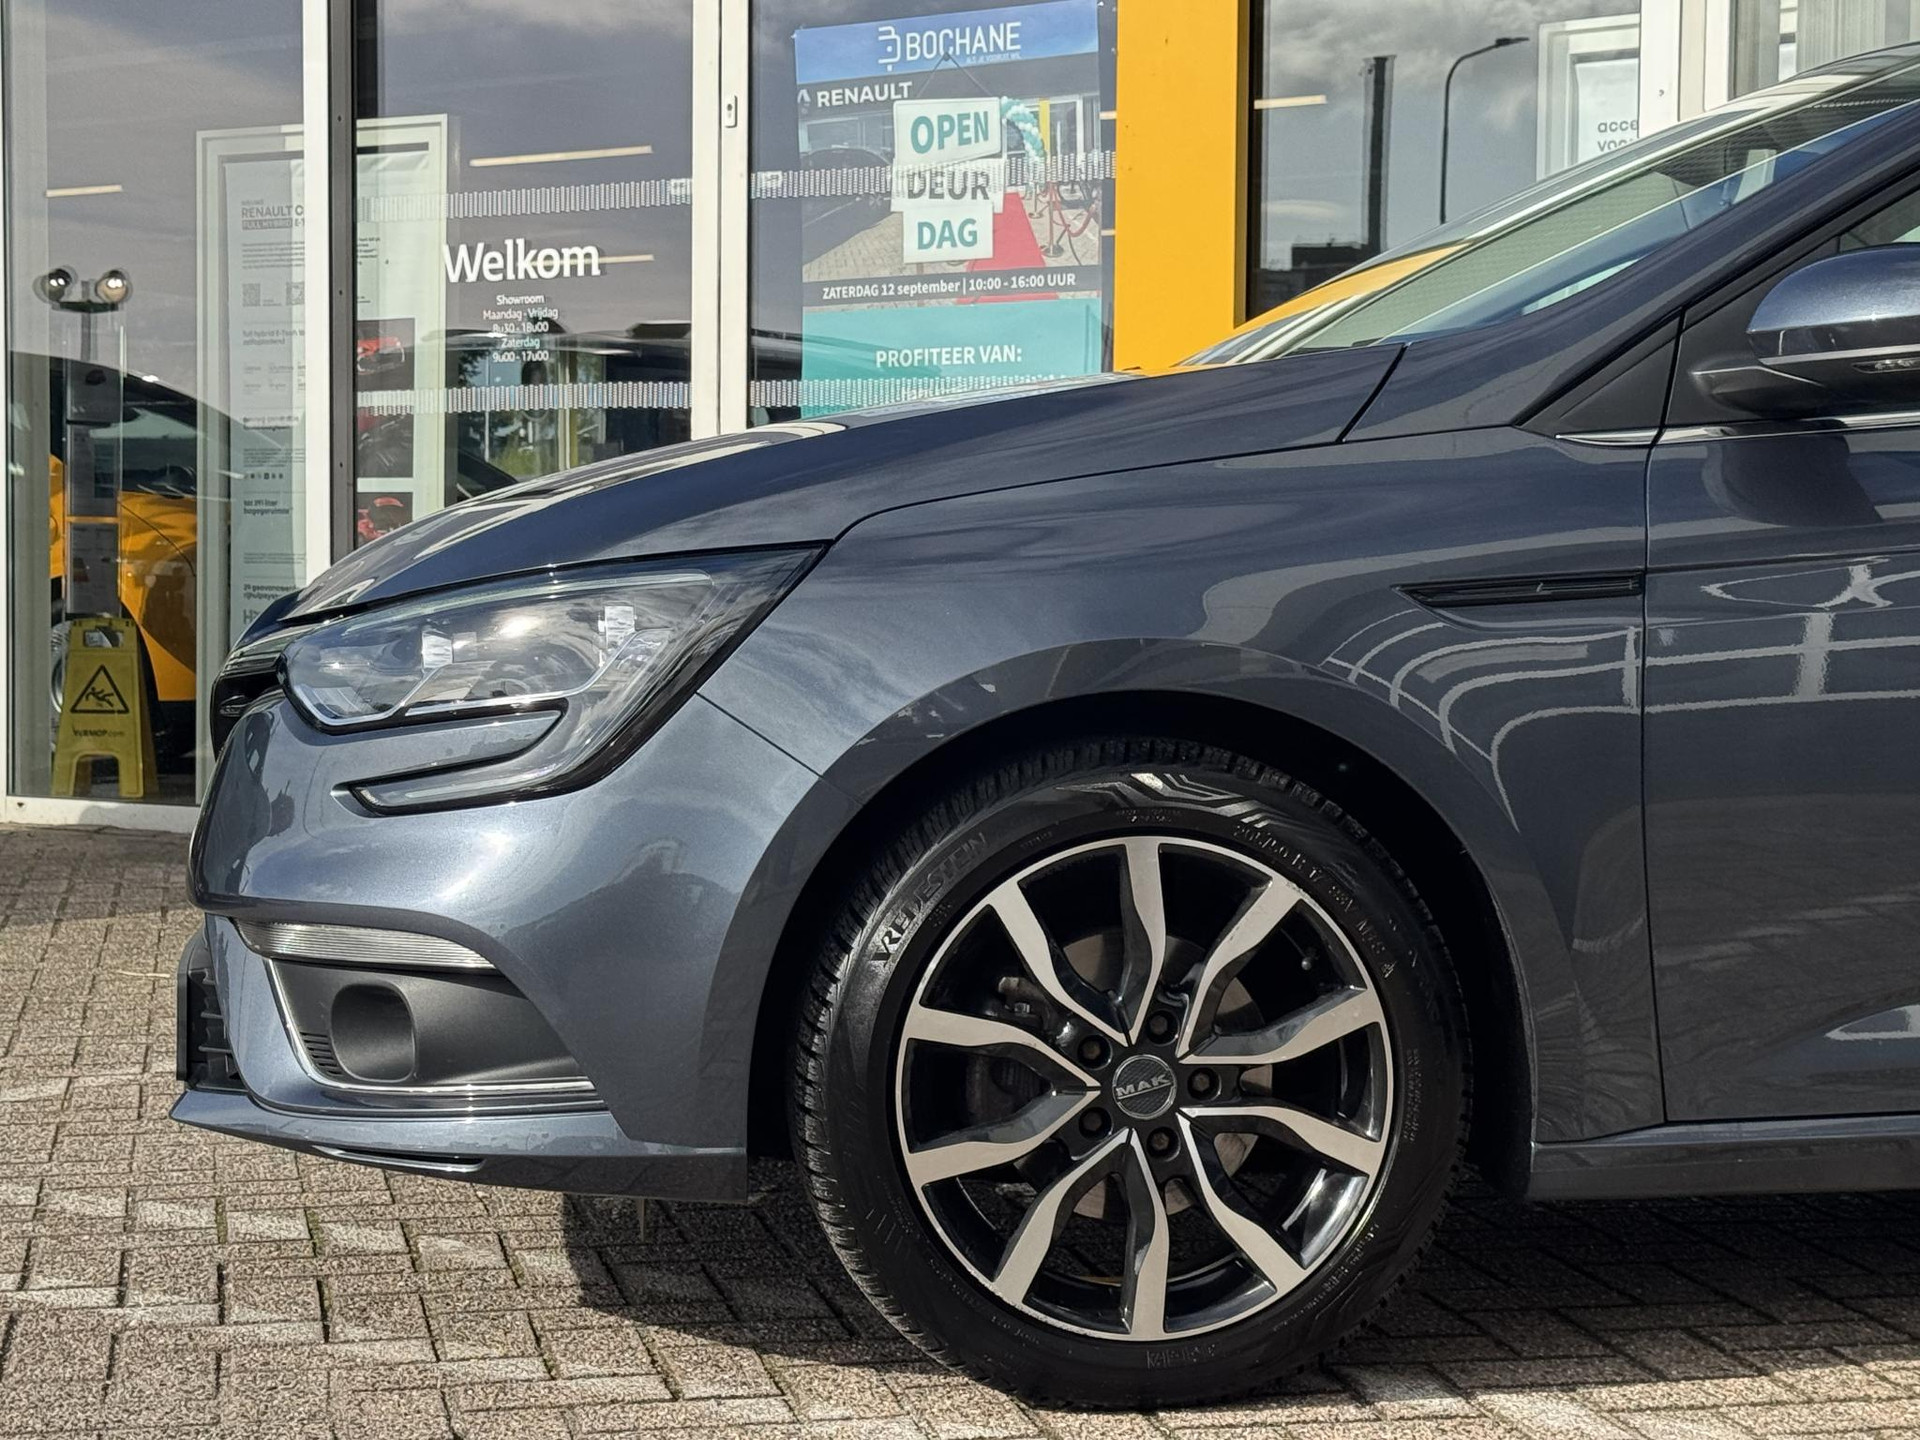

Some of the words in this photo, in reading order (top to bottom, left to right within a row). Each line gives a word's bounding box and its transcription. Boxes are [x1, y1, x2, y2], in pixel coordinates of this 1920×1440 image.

[905, 22, 1022, 62] BOCHANE
[816, 82, 912, 108] RENAULT
[910, 111, 990, 154] OPEN
[907, 168, 990, 200] DEUR
[242, 205, 293, 219] RENAULT
[917, 218, 978, 250] DAG
[443, 238, 601, 283] Welkom
[822, 284, 879, 300] ZATERDAG
[881, 284, 895, 296] 12
[897, 280, 960, 297] september
[969, 278, 1001, 291] 10:00
[1011, 275, 1045, 289] 16:00
[1047, 273, 1076, 287] UUR
[496, 295, 545, 306] Showroom
[483, 309, 523, 321] Maandag
[528, 307, 559, 320] Vrijdag
[522, 321, 549, 332] 18u00
[501, 337, 541, 349] Zaterdag
[493, 352, 515, 363] 9u00
[522, 351, 549, 362] 17u00
[875, 346, 975, 368] PROFITEER
[979, 345, 1023, 363] VAN:
[869, 832, 987, 969] VREDESTEIN
[1115, 1073, 1170, 1097] MAK
